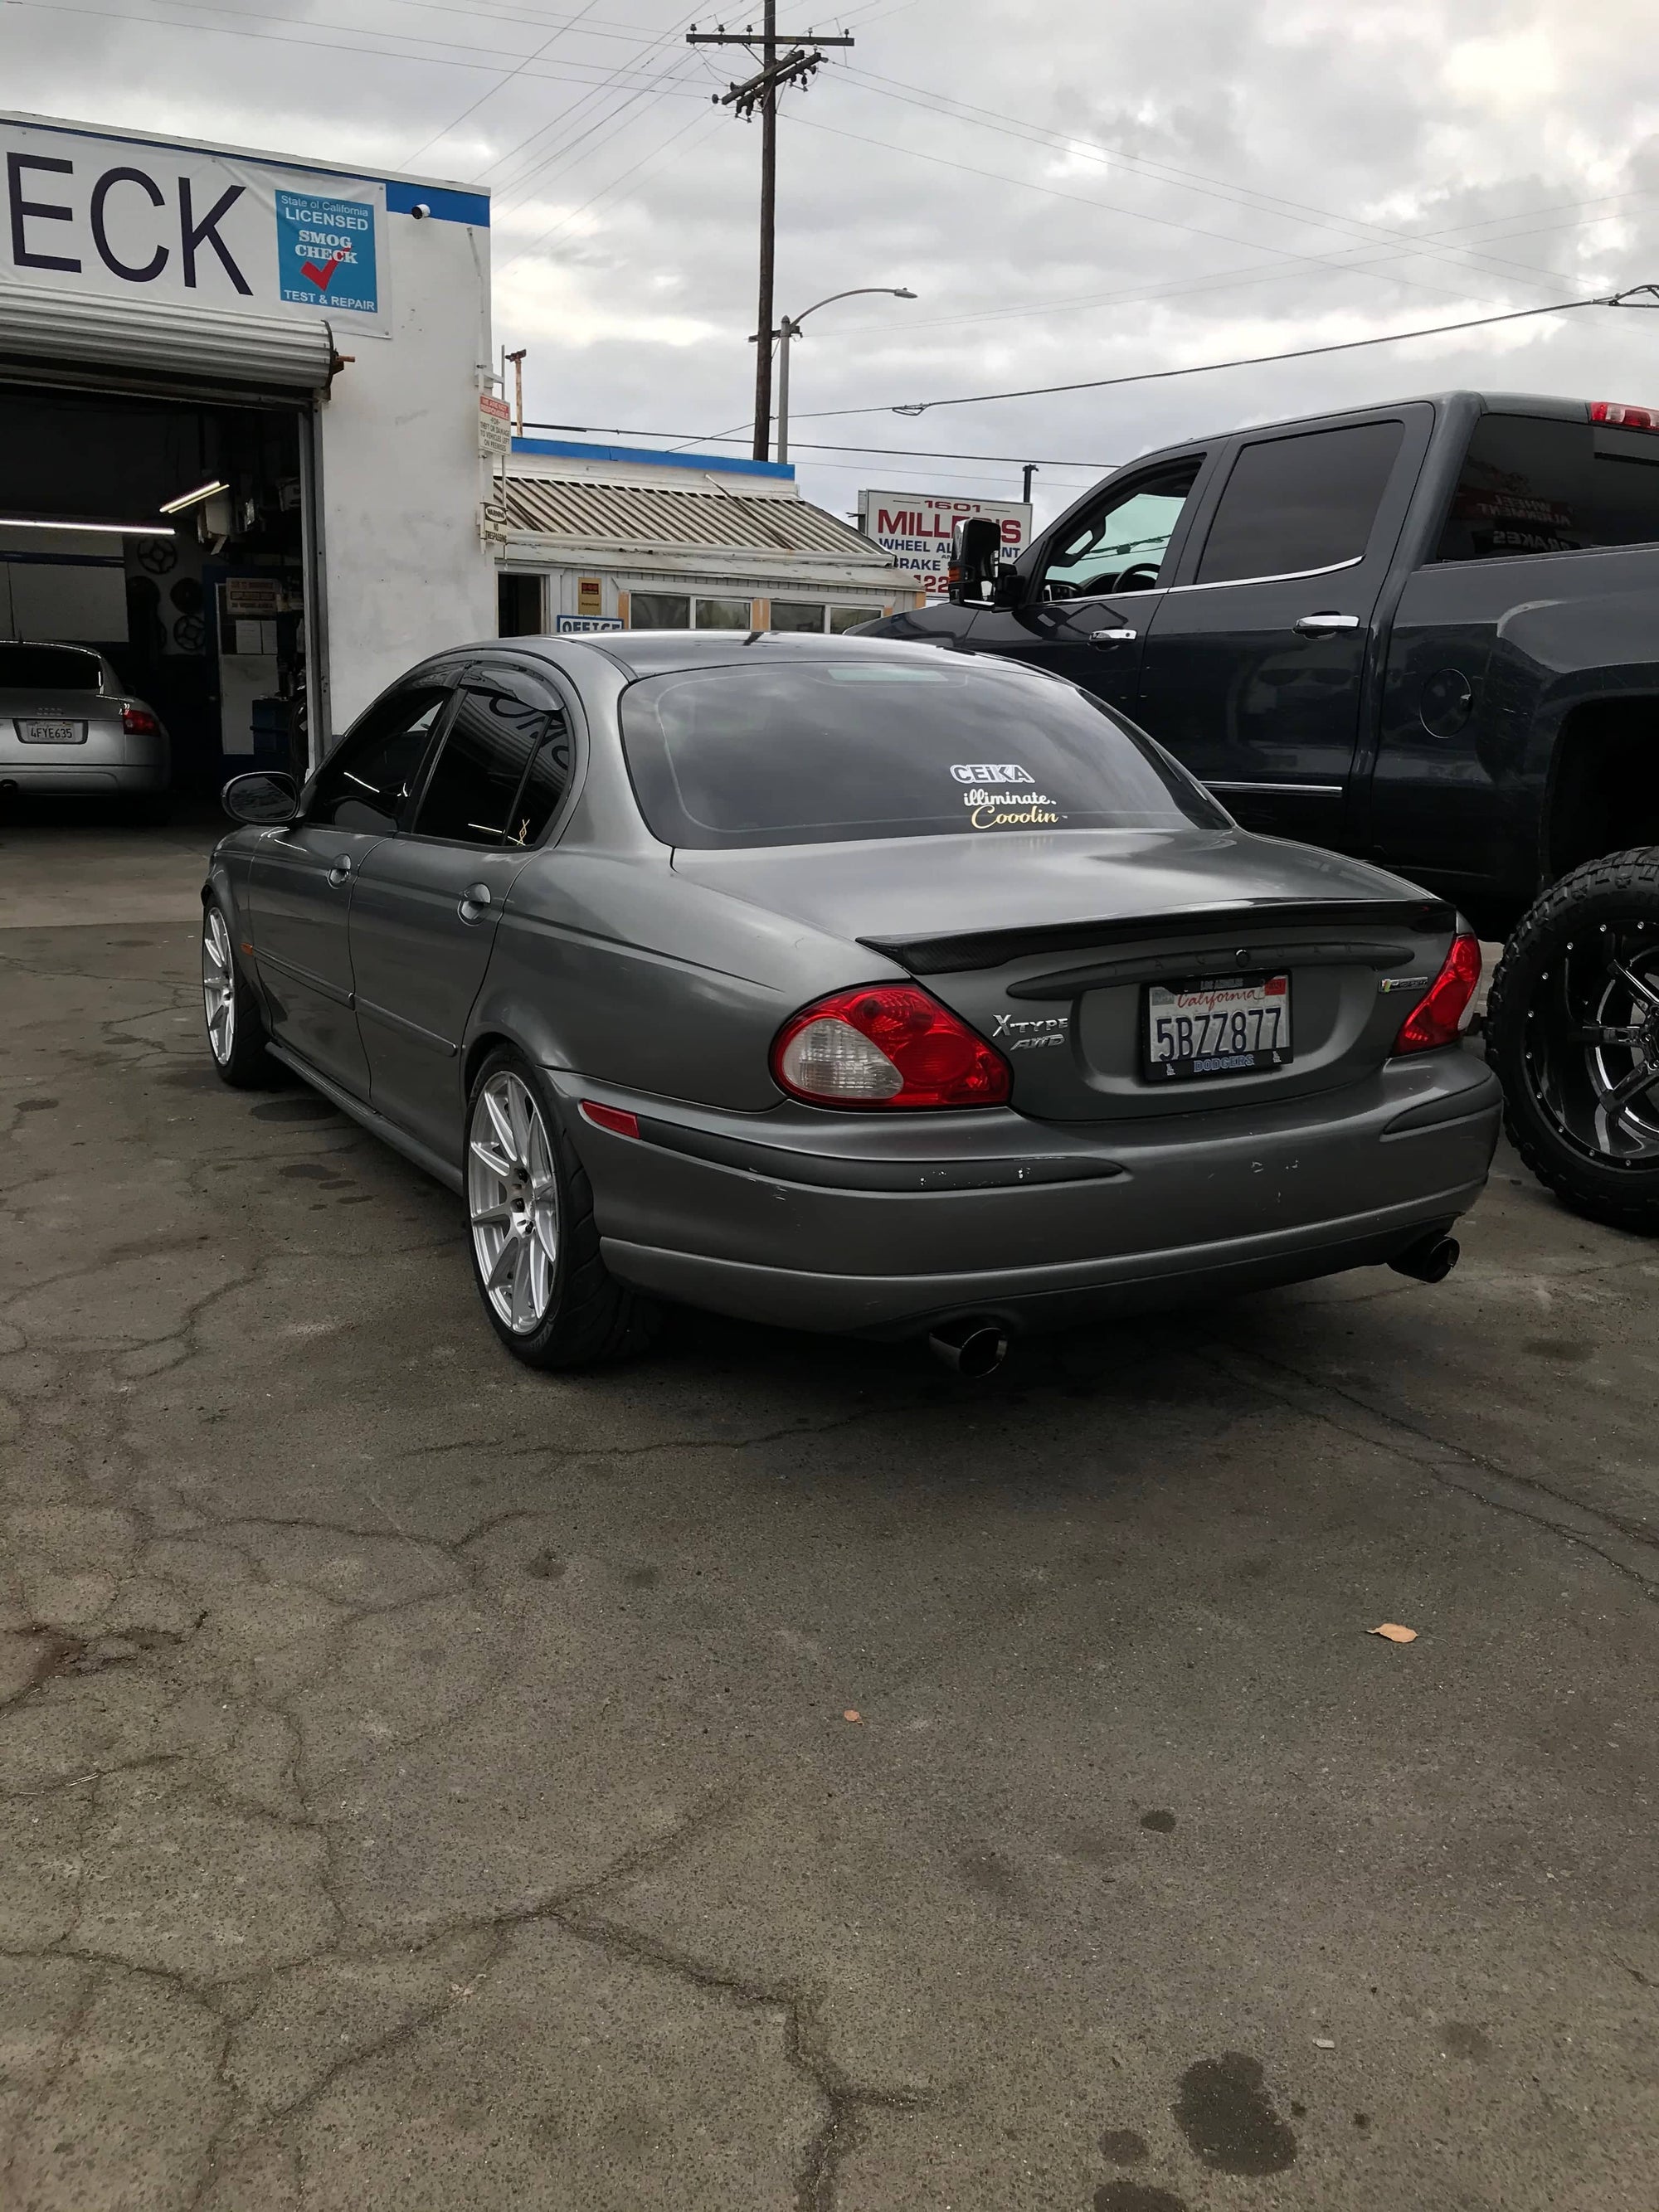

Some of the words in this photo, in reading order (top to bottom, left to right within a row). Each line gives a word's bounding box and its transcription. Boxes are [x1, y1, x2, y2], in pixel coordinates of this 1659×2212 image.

[281, 195, 307, 207] State
[322, 202, 368, 216] California
[285, 207, 368, 231] LICENSED
[299, 230, 352, 248] SMOG
[294, 244, 358, 264] CHECK
[284, 289, 315, 303] TEST
[319, 294, 328, 304] &
[331, 296, 374, 311] REPAIR
[924, 500, 980, 513] 1601
[878, 509, 1021, 543] MILL'S
[879, 538, 931, 552] WHEEL
[31, 727, 73, 738] 4FYE635
[1176, 989, 1256, 1011] California
[992, 1014, 1068, 1037] X-TYPE
[1156, 1007, 1282, 1062] 5BZZ877
[1010, 1033, 1065, 1051] AWD
[1194, 1054, 1254, 1072] DODGERS
